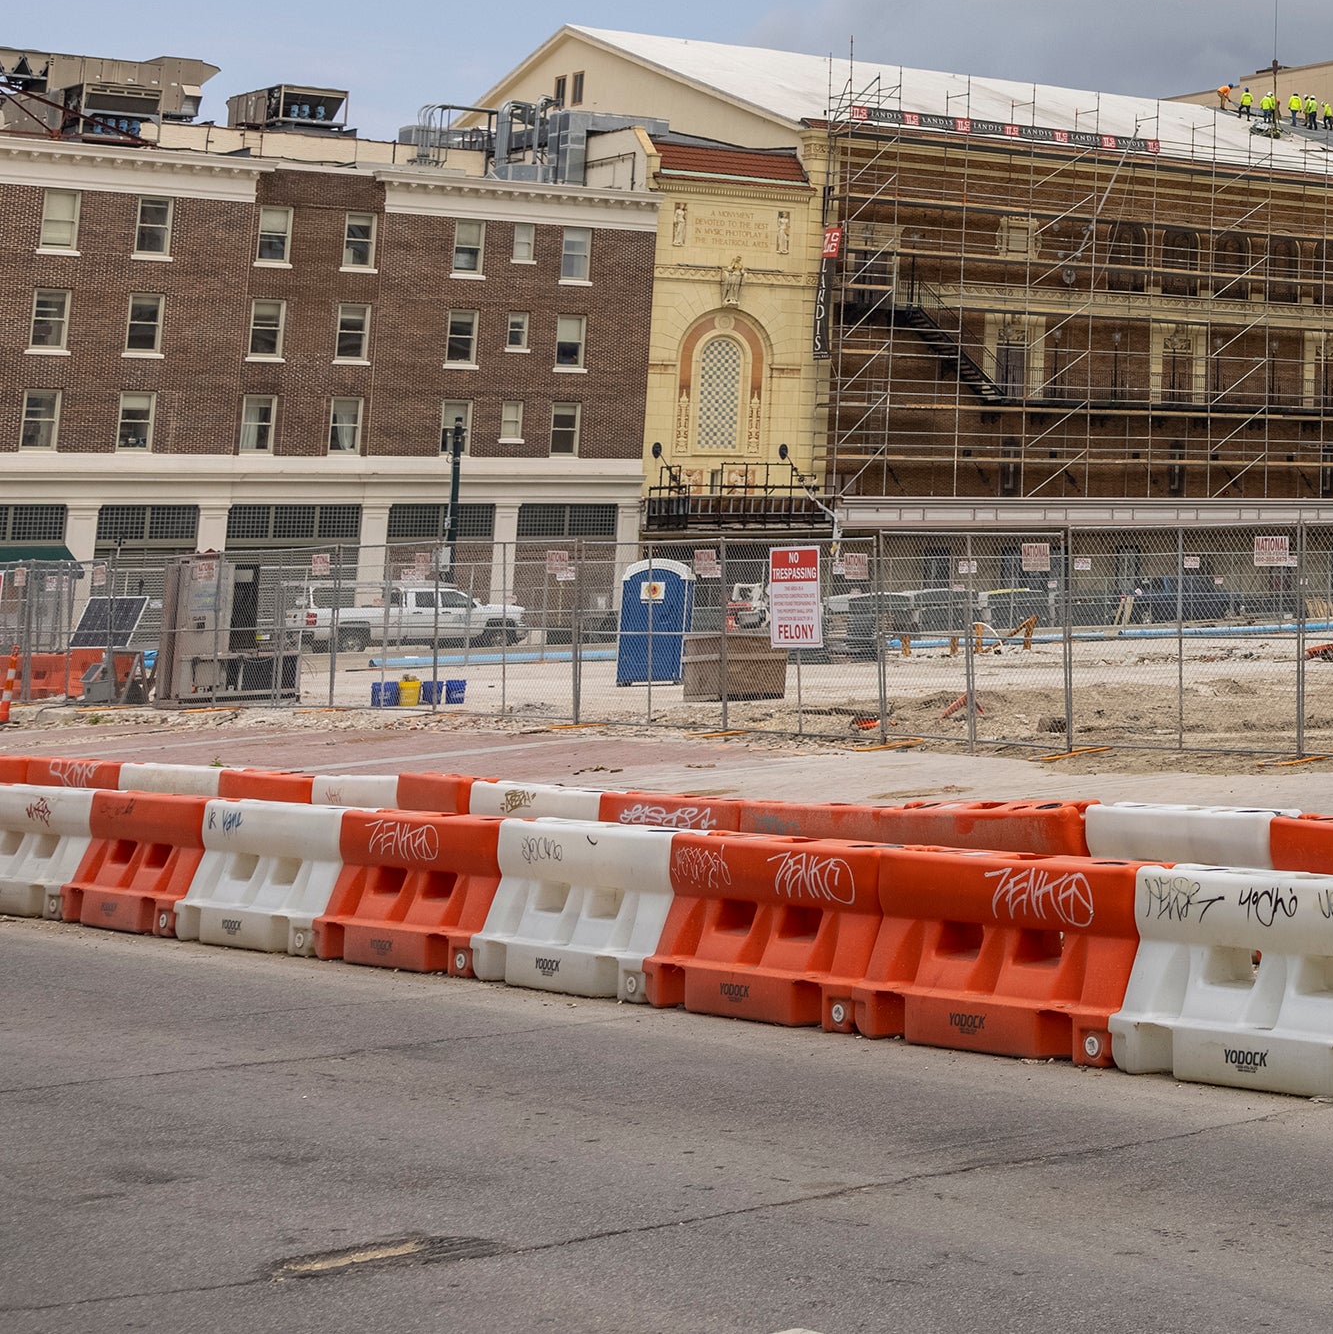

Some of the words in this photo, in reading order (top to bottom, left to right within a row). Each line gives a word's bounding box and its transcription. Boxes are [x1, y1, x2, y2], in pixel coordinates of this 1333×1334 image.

[870, 110, 902, 119] LANDIS
[922, 117, 954, 126] LANDIS
[973, 122, 1002, 132] LANDIS
[1022, 127, 1052, 137] LANDIS
[1071, 134, 1100, 142] LANDIS
[694, 217, 725, 226] DEVOTED
[728, 220, 737, 228] TO
[740, 221, 751, 229] THE
[754, 222, 768, 230] BEST
[725, 229, 761, 239] PHOTOPLAY
[694, 236, 706, 244] THE
[712, 237, 749, 247] THEATRICAL
[814, 257, 828, 352] LANDIS
[1022, 544, 1049, 557] NATIONAL
[1255, 537, 1288, 551] NATIONAL
[788, 552, 800, 564] NO
[772, 567, 816, 580] TRESPASSING
[778, 624, 815, 639] FELONY
[535, 957, 561, 972] YODOCK
[720, 982, 750, 998] YODOCK
[949, 1012, 986, 1029] YODOCK
[1224, 1049, 1268, 1067] YODOCK
